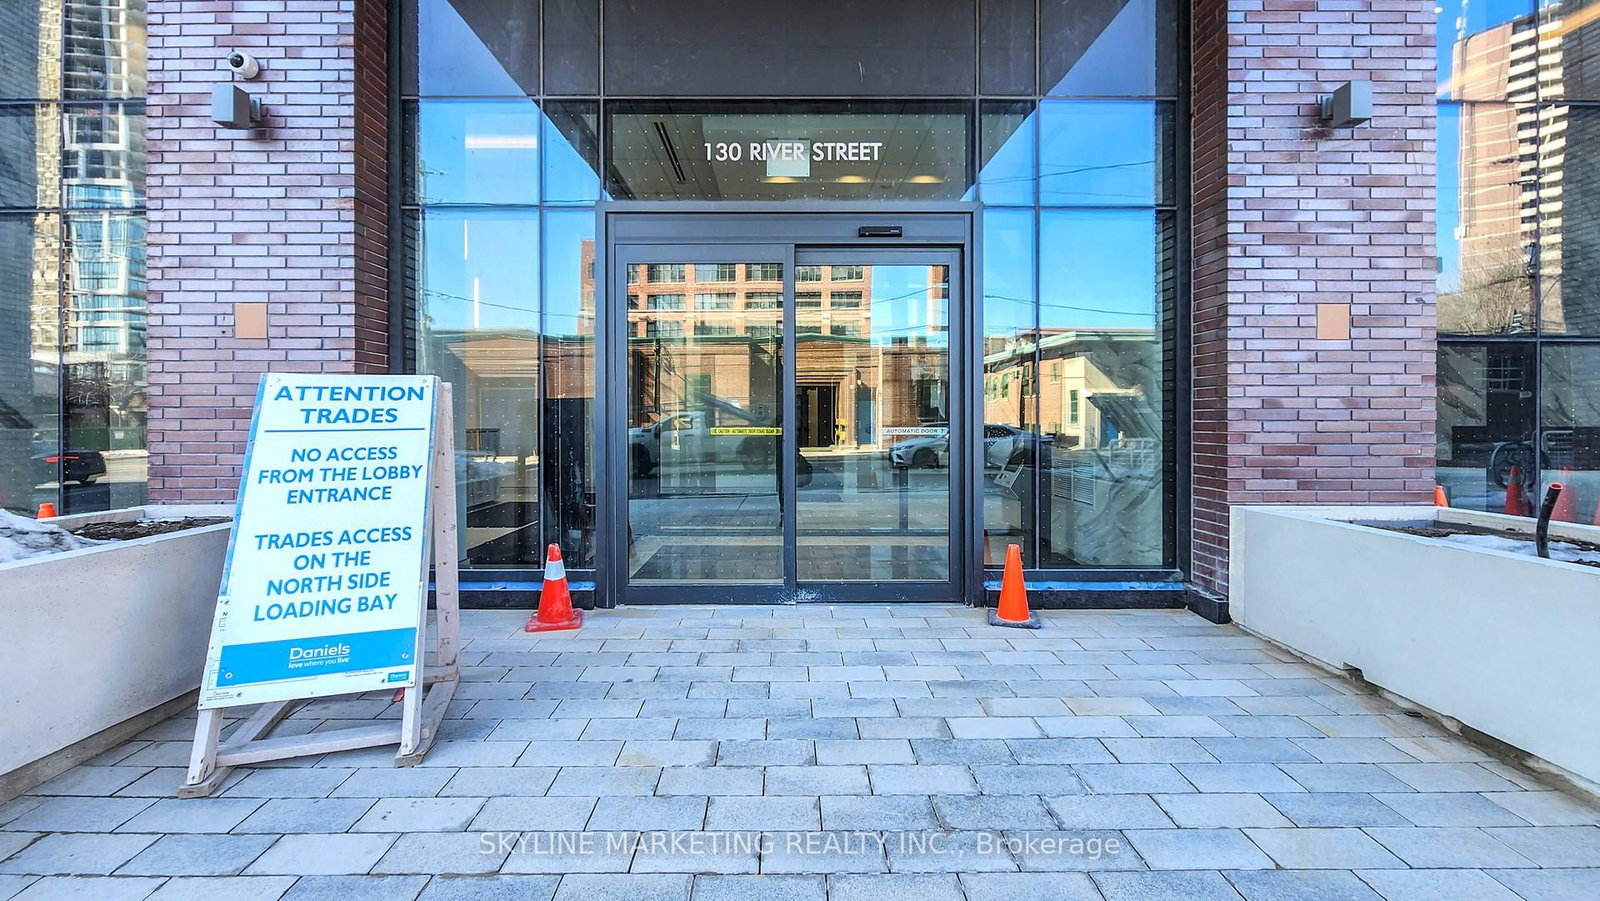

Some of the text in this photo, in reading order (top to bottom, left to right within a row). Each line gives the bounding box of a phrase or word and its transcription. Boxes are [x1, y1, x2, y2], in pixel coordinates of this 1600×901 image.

[704, 142, 882, 161] 130 RIVER STREET
[274, 385, 425, 401] ATTENTION
[300, 408, 398, 424] TRADES
[291, 446, 398, 462] NO ACCESS
[258, 465, 423, 484] FROM THE LOBBY
[287, 486, 392, 504] ENTRANCE
[254, 526, 412, 550] TRADES ACCESS
[293, 550, 371, 570] ON THE
[266, 571, 390, 596] NORTH SIDE
[253, 593, 398, 622] LOADING BAY
[289, 643, 350, 660] Daniels
[304, 660, 324, 668] where
